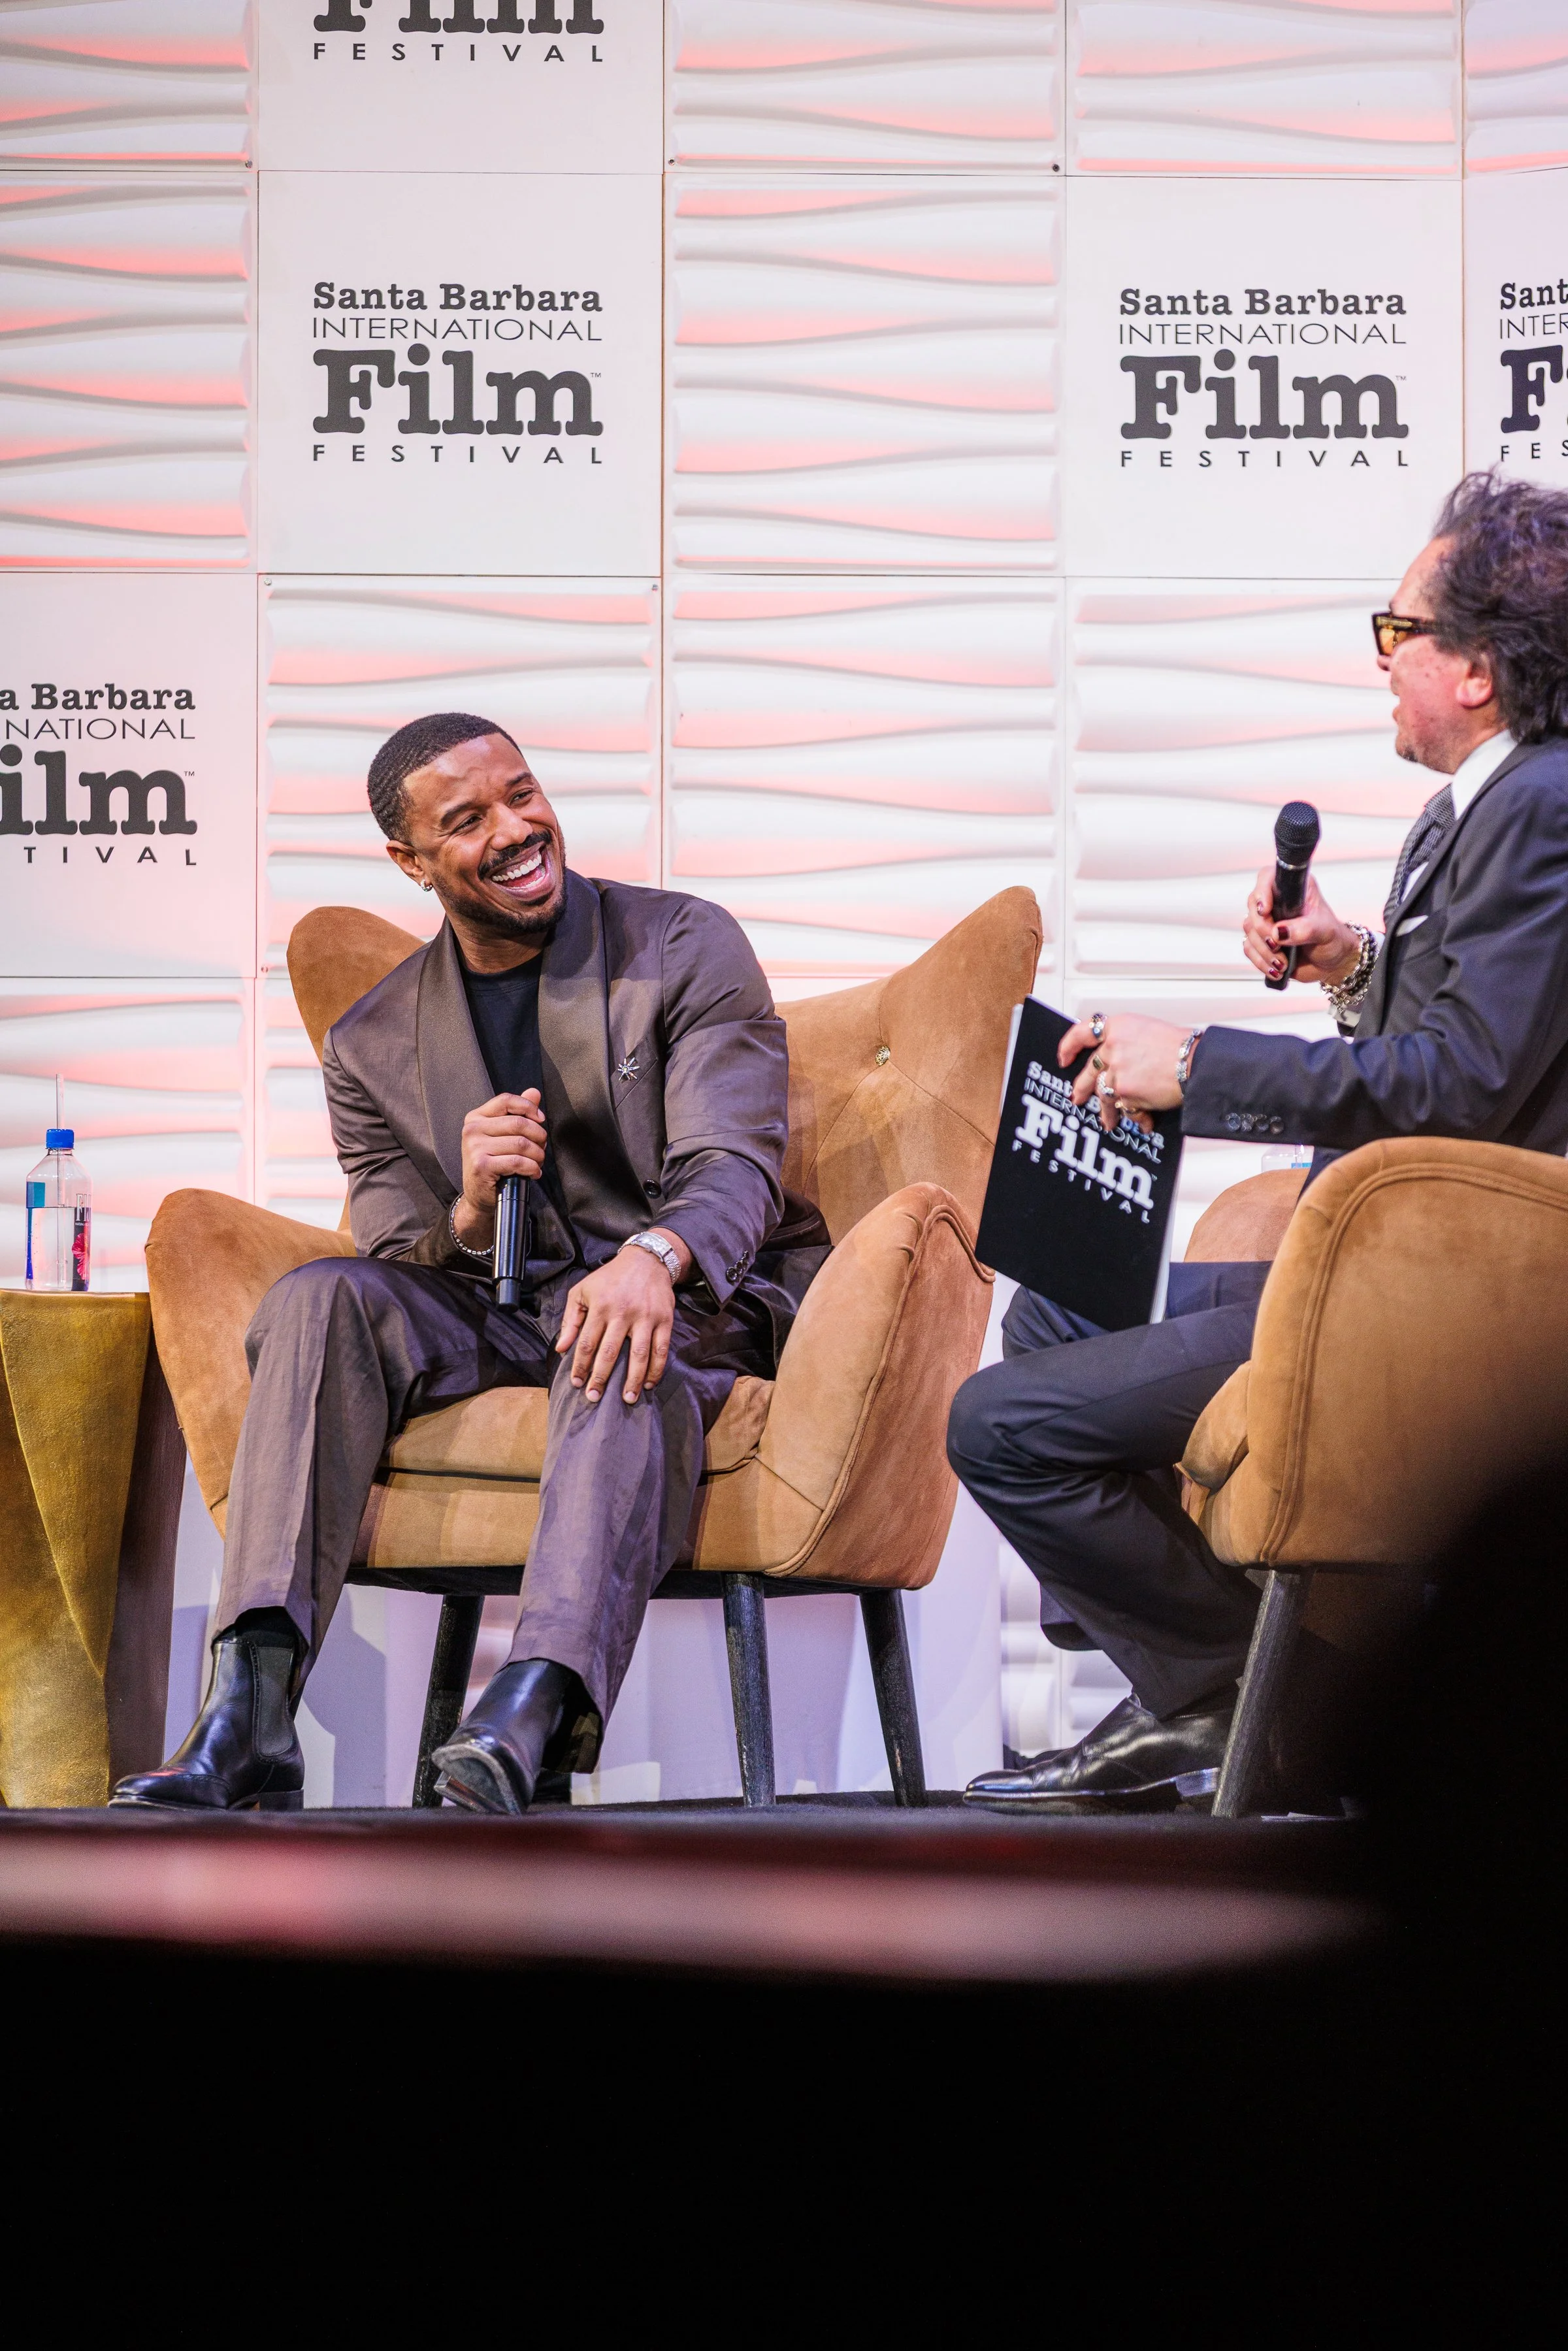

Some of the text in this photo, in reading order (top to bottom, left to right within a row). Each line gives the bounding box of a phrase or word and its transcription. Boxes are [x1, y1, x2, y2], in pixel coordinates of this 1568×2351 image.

[314, 43, 602, 62] FESTIVAL
[314, 282, 602, 312] Santa Barbara
[1120, 289, 1406, 315] Santa Barbara
[314, 318, 602, 340] INTERNATIONAL
[1120, 323, 1406, 344] INTERNATIONAL
[313, 343, 604, 436] Film
[1120, 349, 1408, 439] Film
[314, 444, 602, 463] FESTIVAL
[1121, 450, 1408, 467] FESTIVAL
[31, 683, 195, 710] Barbara
[7, 718, 195, 739] NATIONAL
[24, 847, 196, 865] TIVAL
[1015, 1093, 1154, 1209] Film
[1012, 1139, 1150, 1224] FESTIVAL
